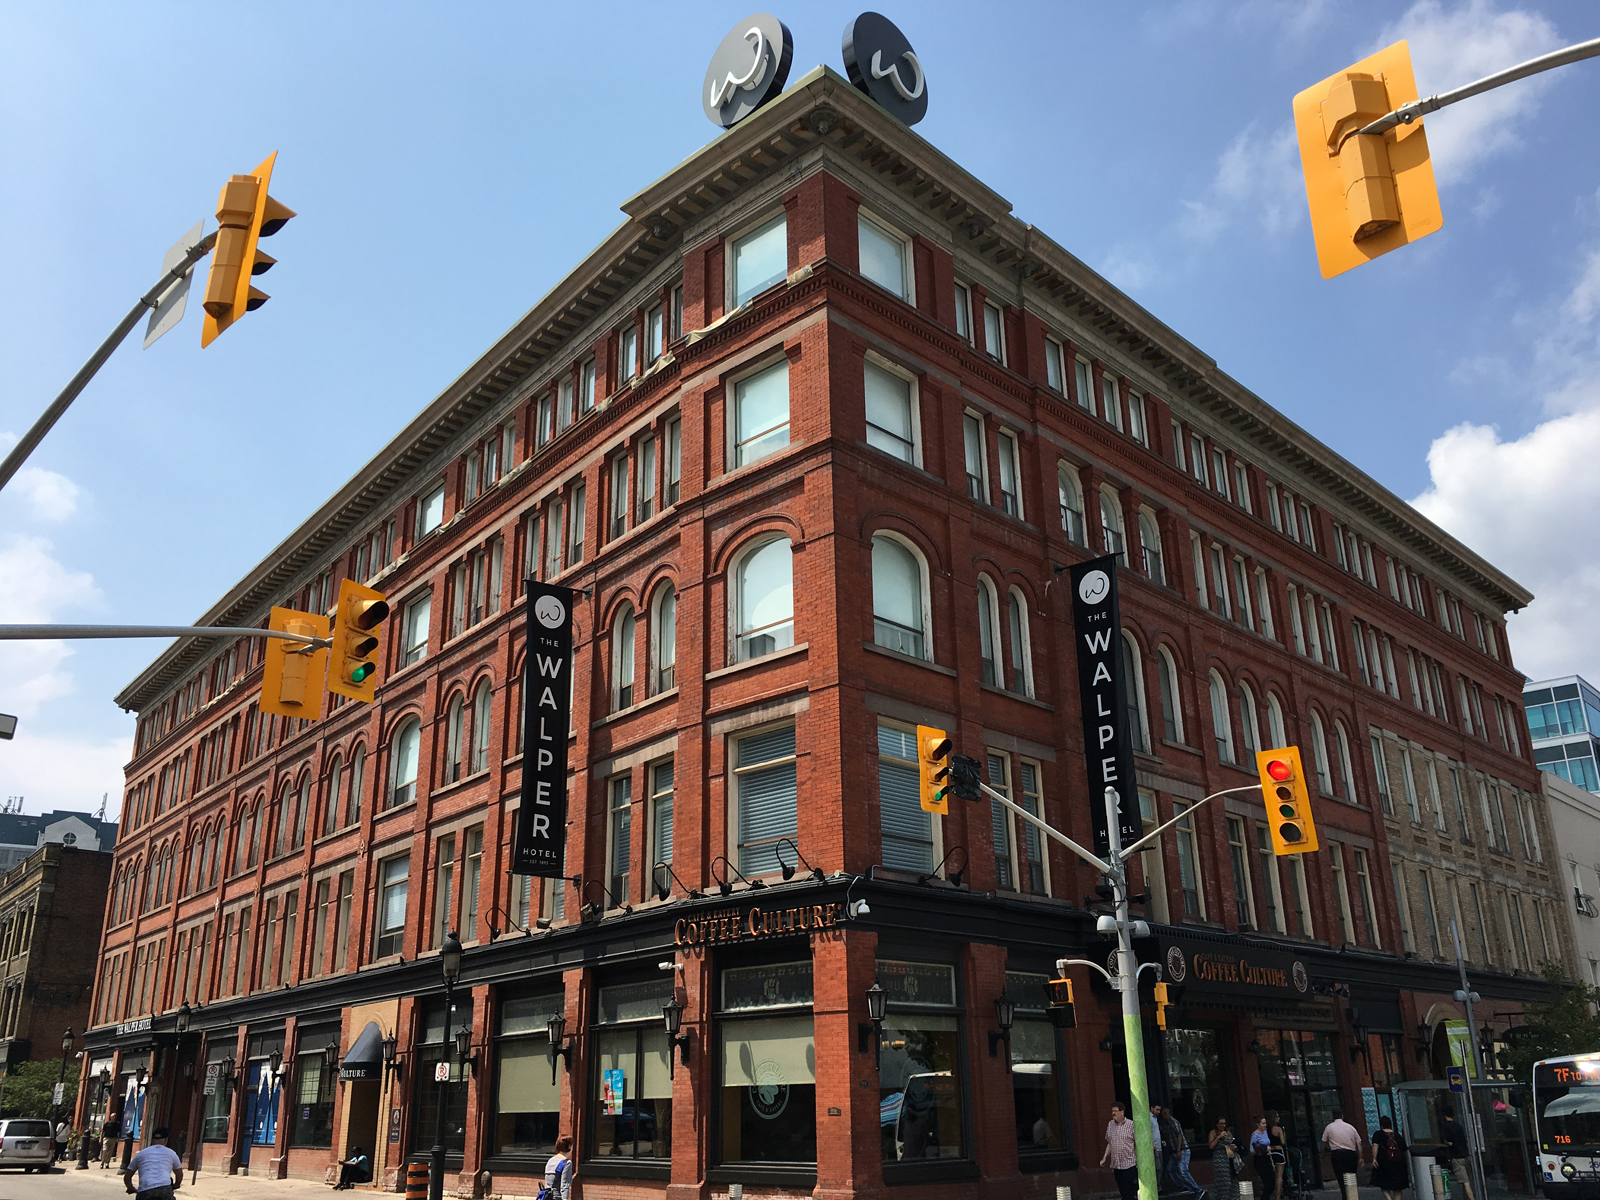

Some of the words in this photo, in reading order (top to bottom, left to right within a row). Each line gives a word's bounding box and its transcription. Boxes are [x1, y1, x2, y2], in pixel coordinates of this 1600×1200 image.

[1087, 611, 1107, 623] THE
[540, 637, 559, 648] THE
[532, 653, 563, 840] WALPER
[1099, 825, 1135, 838] HEL
[522, 847, 557, 859] HOTEL
[713, 907, 741, 919] EATERY
[674, 917, 742, 946] COFFEE
[748, 903, 837, 937] CULTURE
[1193, 954, 1239, 983] COFFEE
[1239, 959, 1288, 988] CULTURE
[116, 1024, 124, 1035] THE
[1553, 1068, 1570, 1083] 7F
[1570, 1071, 1582, 1081] TO
[1554, 1135, 1571, 1144] 716
